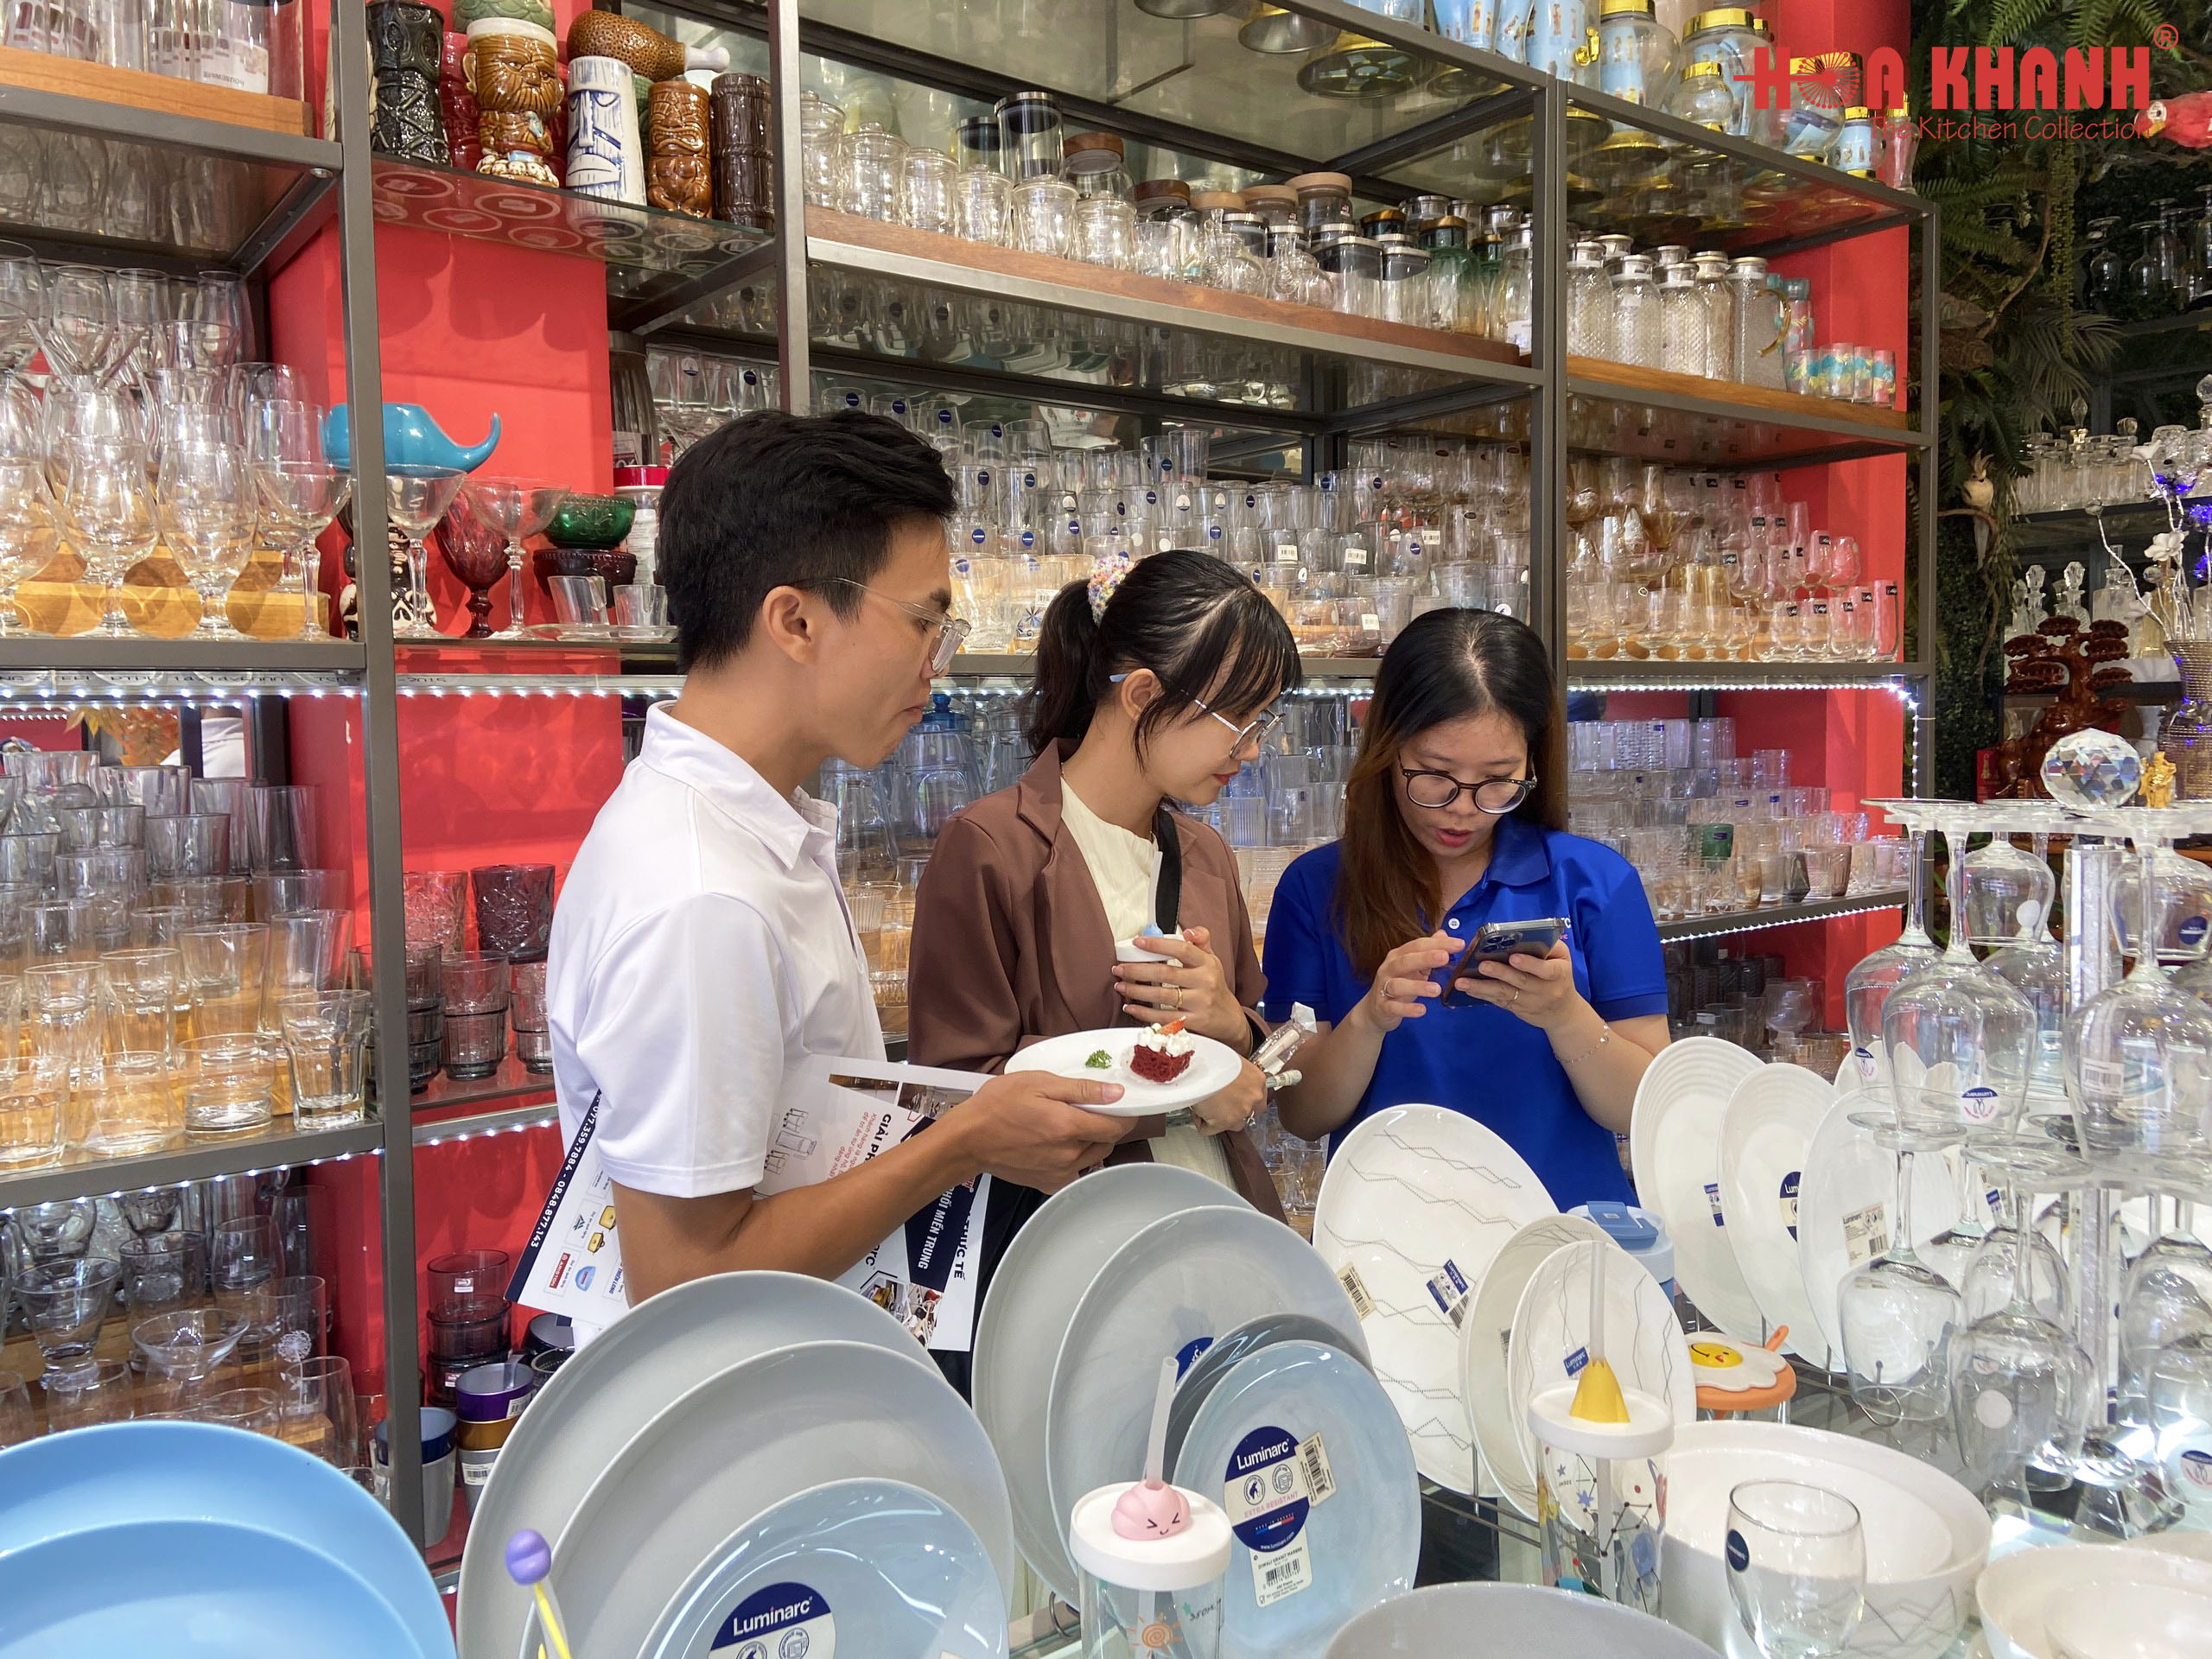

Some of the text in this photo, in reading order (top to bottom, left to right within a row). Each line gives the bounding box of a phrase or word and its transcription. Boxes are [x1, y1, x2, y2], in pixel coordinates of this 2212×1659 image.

[531, 1179, 566, 1249] 0848.877.143
[918, 1234, 938, 1270] TRUNG
[1236, 1440, 1289, 1471] Luminarc
[733, 1599, 810, 1637] Luminarc
